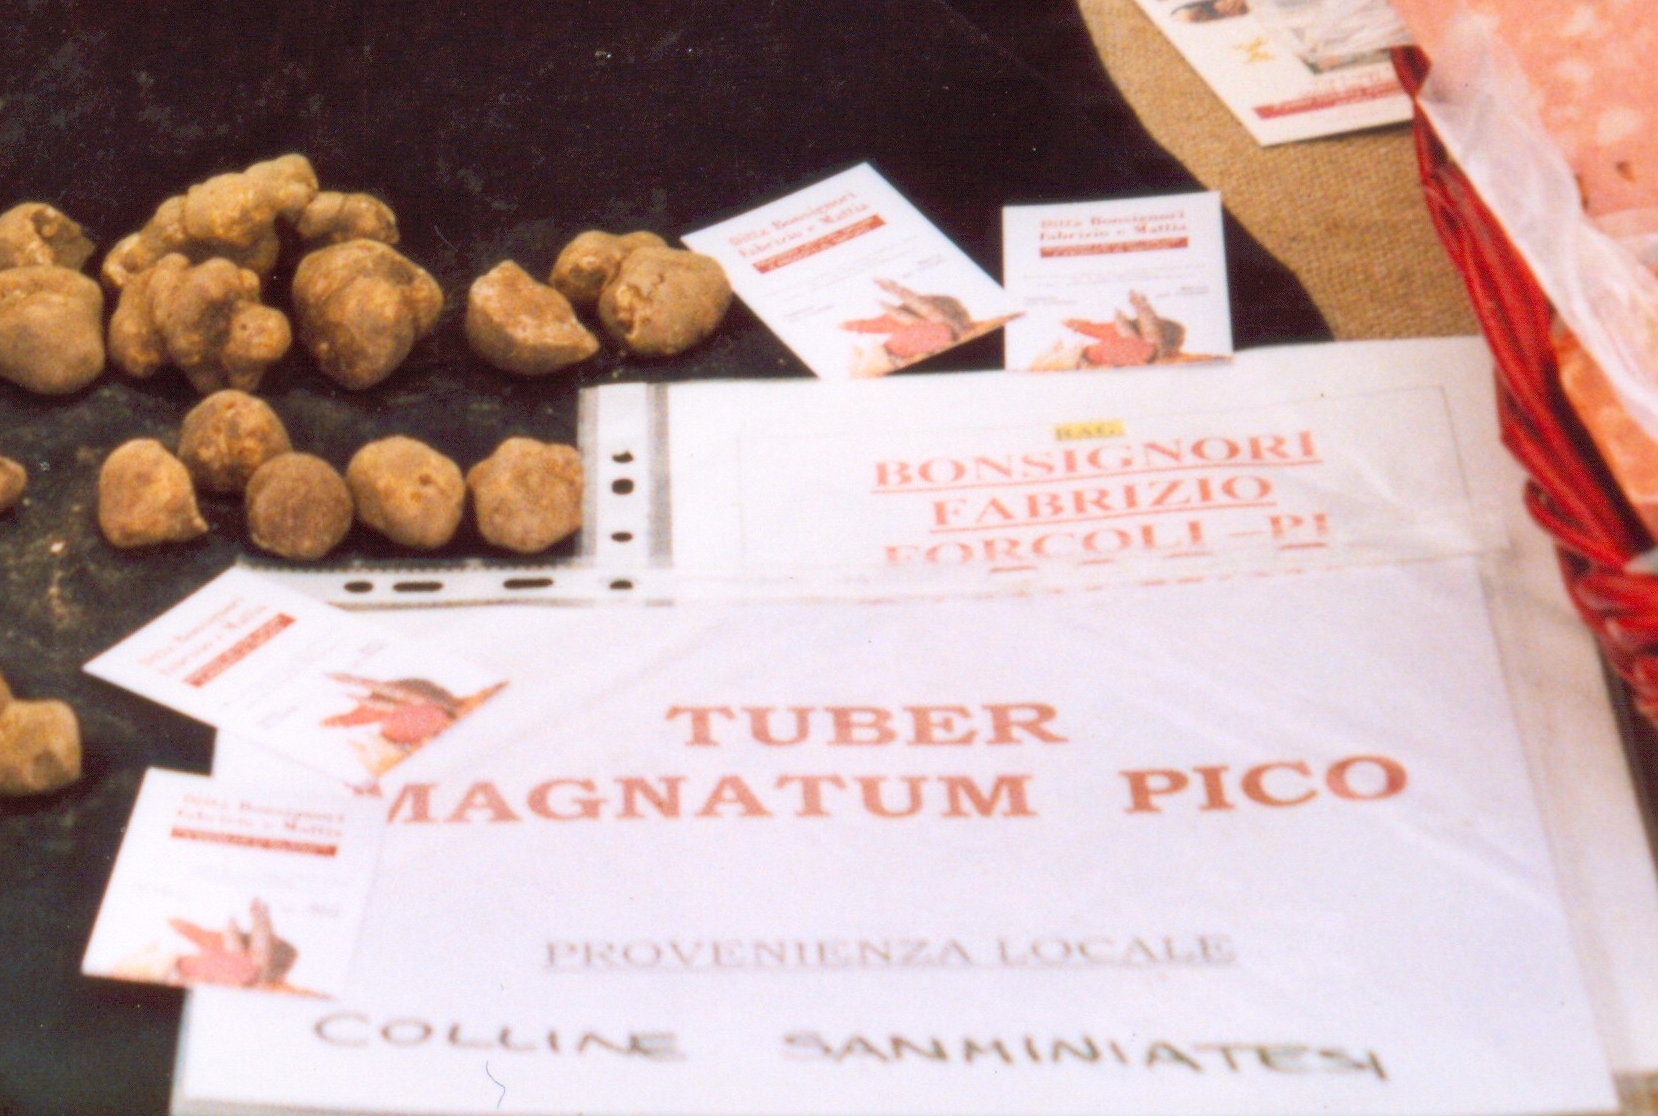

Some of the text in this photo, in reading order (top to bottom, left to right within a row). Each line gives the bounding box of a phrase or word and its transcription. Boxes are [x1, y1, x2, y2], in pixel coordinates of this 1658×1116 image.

[873, 429, 1318, 488] BONSIGNORI
[930, 475, 1274, 527] FABRIZIO
[884, 520, 1206, 566] FORCOLI
[665, 703, 1070, 749] TUBER
[348, 752, 1410, 825] MAGNATUM PICO
[543, 933, 1240, 969] PROVENIENZA LOCALE
[313, 1011, 1390, 1083] COLLINE SANMINIATESI
